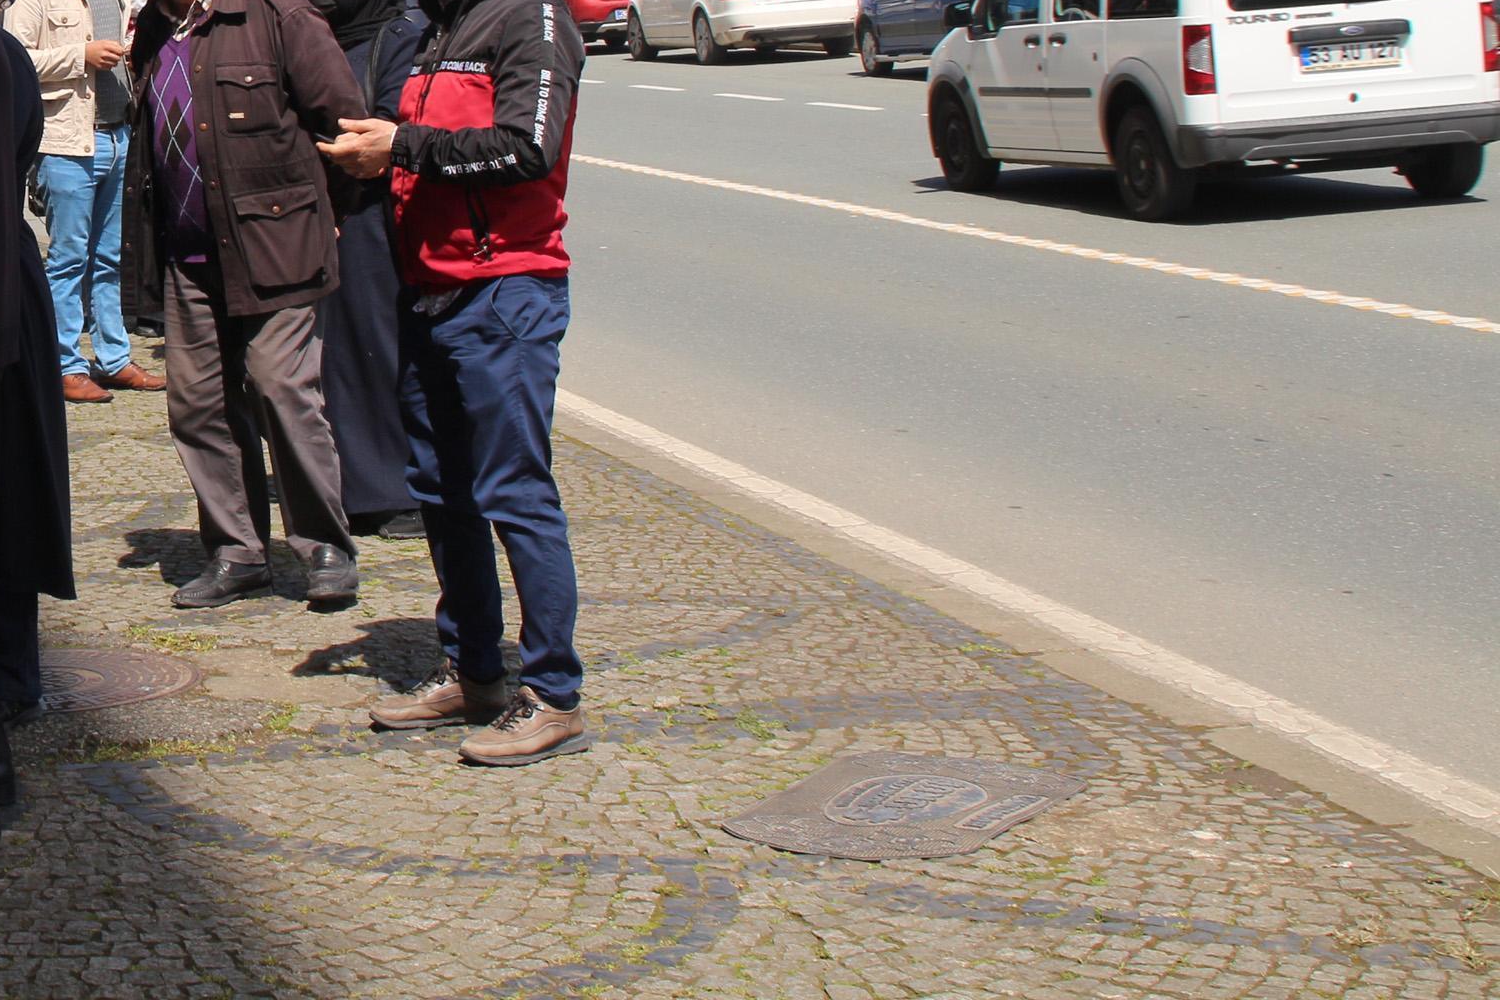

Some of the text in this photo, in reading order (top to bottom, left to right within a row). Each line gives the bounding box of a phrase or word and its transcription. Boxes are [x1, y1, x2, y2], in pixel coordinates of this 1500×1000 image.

[1226, 12, 1290, 25] TOURNEO
[542, 19, 554, 43] BACK
[464, 61, 487, 73] BACK
[532, 69, 552, 148] BILL TO COME BACK
